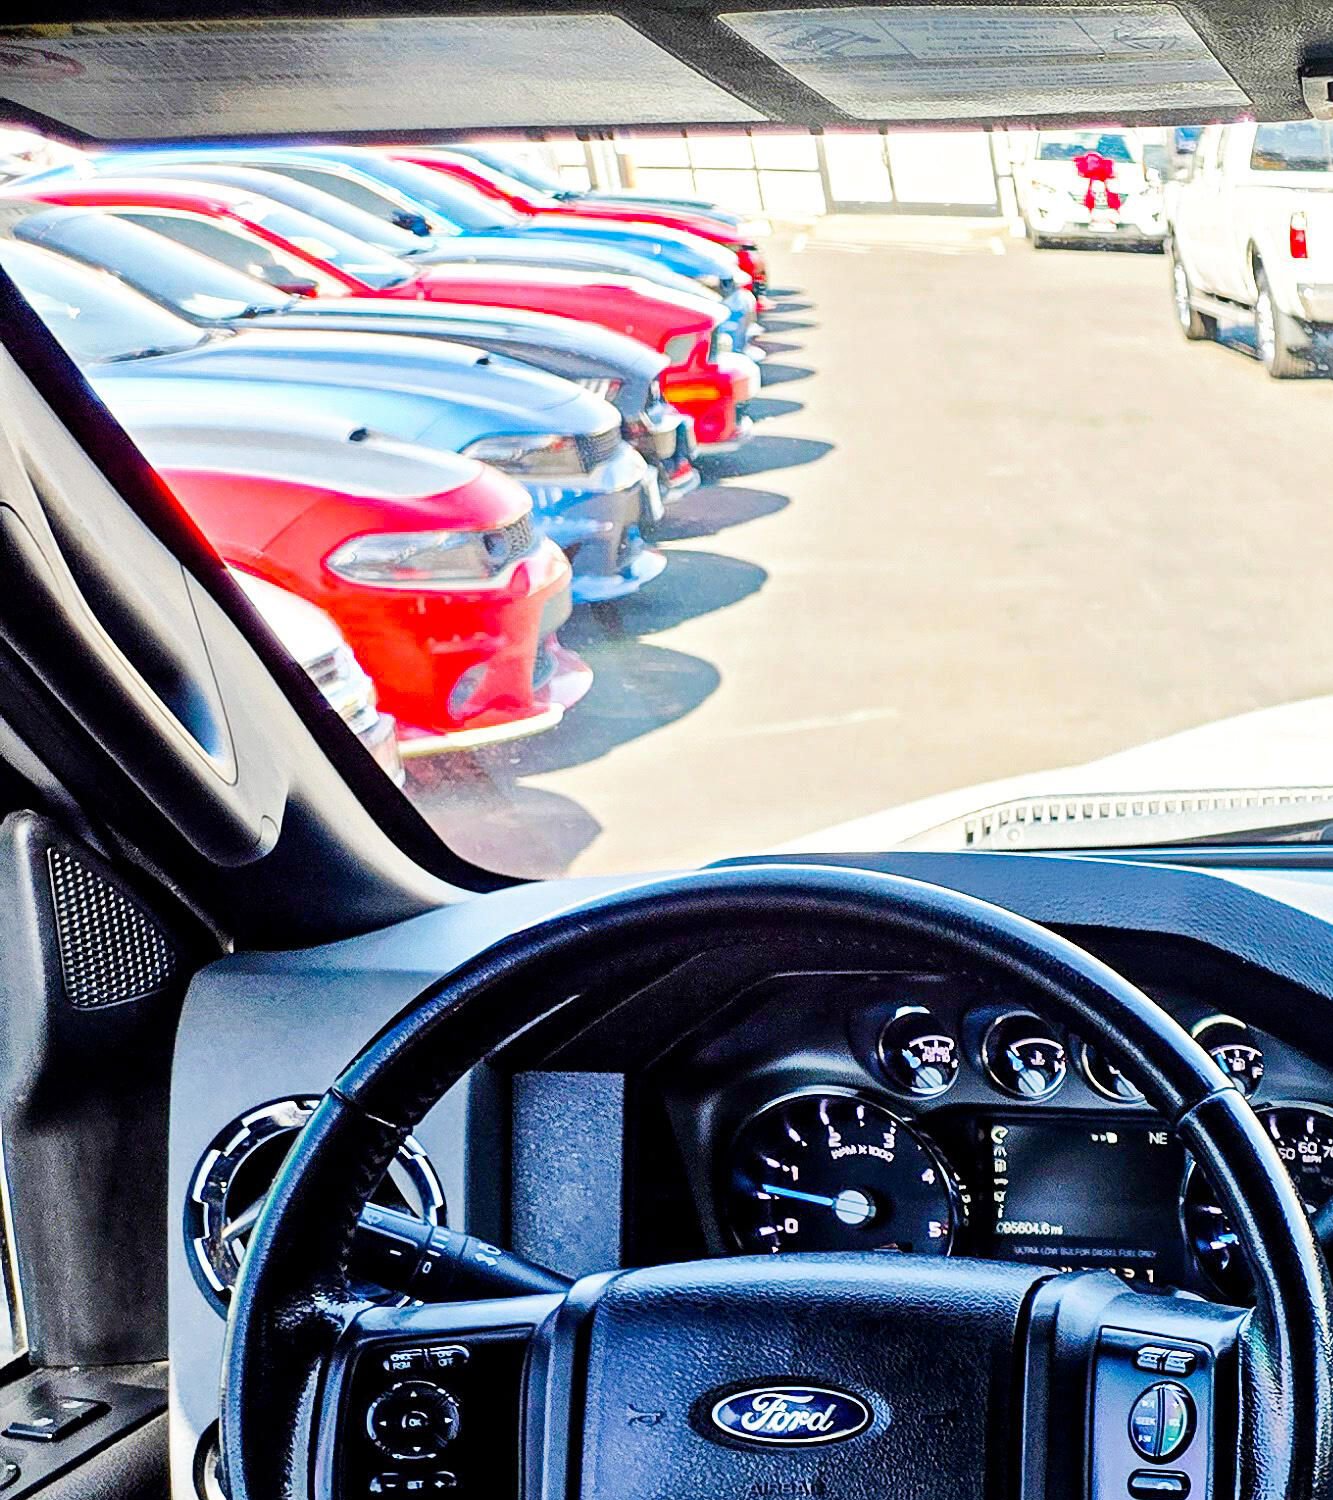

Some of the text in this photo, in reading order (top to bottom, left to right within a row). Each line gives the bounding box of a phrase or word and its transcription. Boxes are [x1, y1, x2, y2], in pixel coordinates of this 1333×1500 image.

[828, 1132, 842, 1147] 2
[883, 1133, 895, 1148] 3
[1149, 1132, 1168, 1144] NE
[869, 1145, 894, 1162] 1000
[1298, 1142, 1318, 1154] 60
[1302, 1154, 1322, 1164] MPH
[792, 1166, 799, 1181] 1
[922, 1168, 935, 1184] 4
[785, 1218, 798, 1233] 0
[928, 1222, 941, 1238] 5
[741, 1392, 837, 1432] Ford
